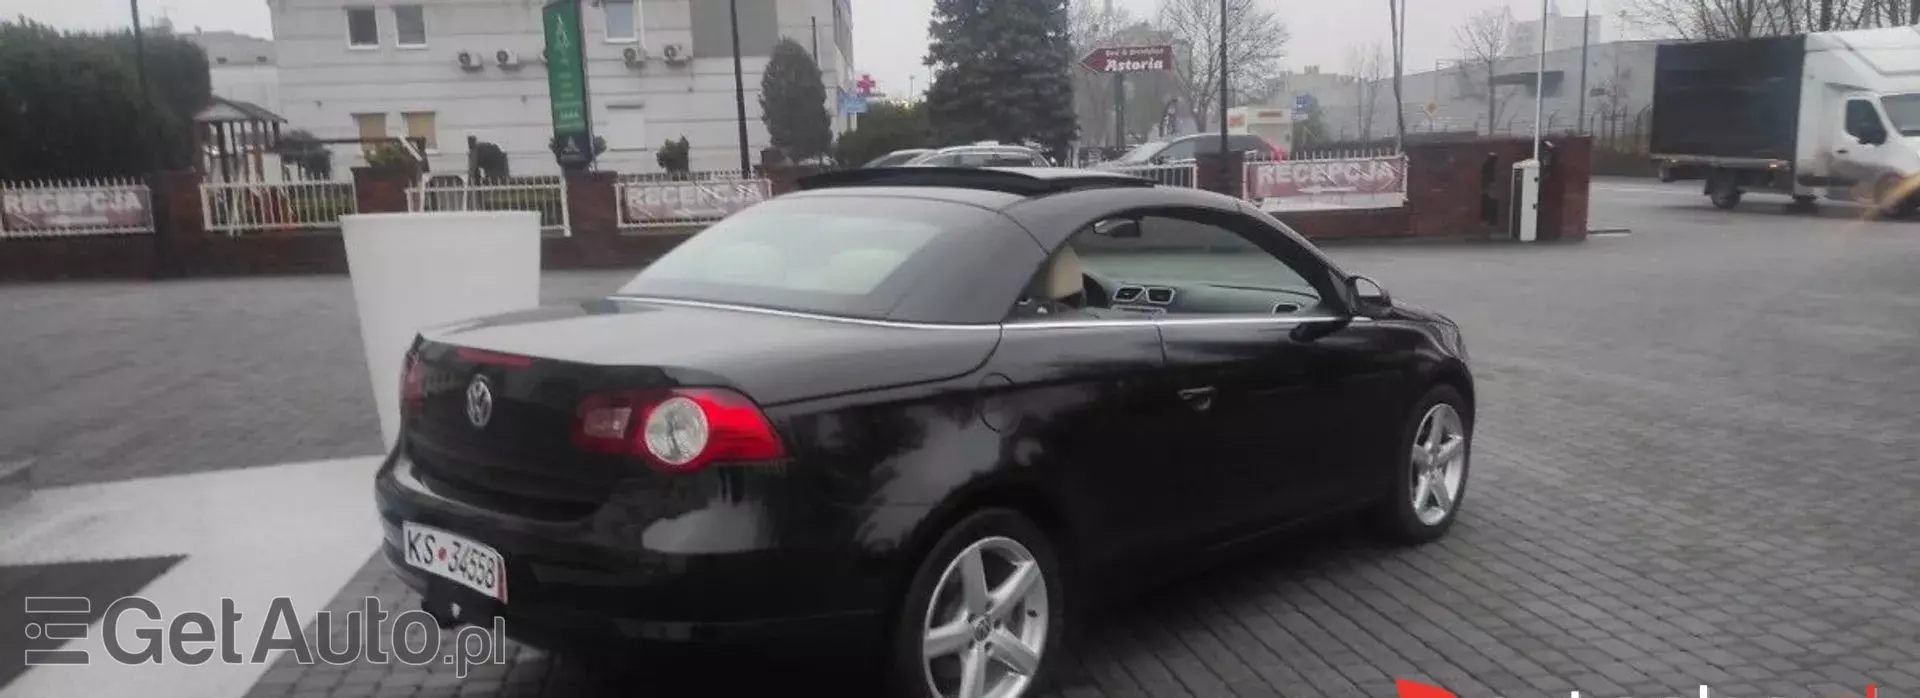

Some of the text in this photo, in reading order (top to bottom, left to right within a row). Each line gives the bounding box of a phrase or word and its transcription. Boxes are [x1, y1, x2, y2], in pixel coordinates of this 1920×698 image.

[1104, 58, 1163, 71] Astoria
[1257, 161, 1396, 185] RECEPCJA
[3, 191, 143, 213] RECEPCJA
[408, 529, 495, 588] KS 34558
